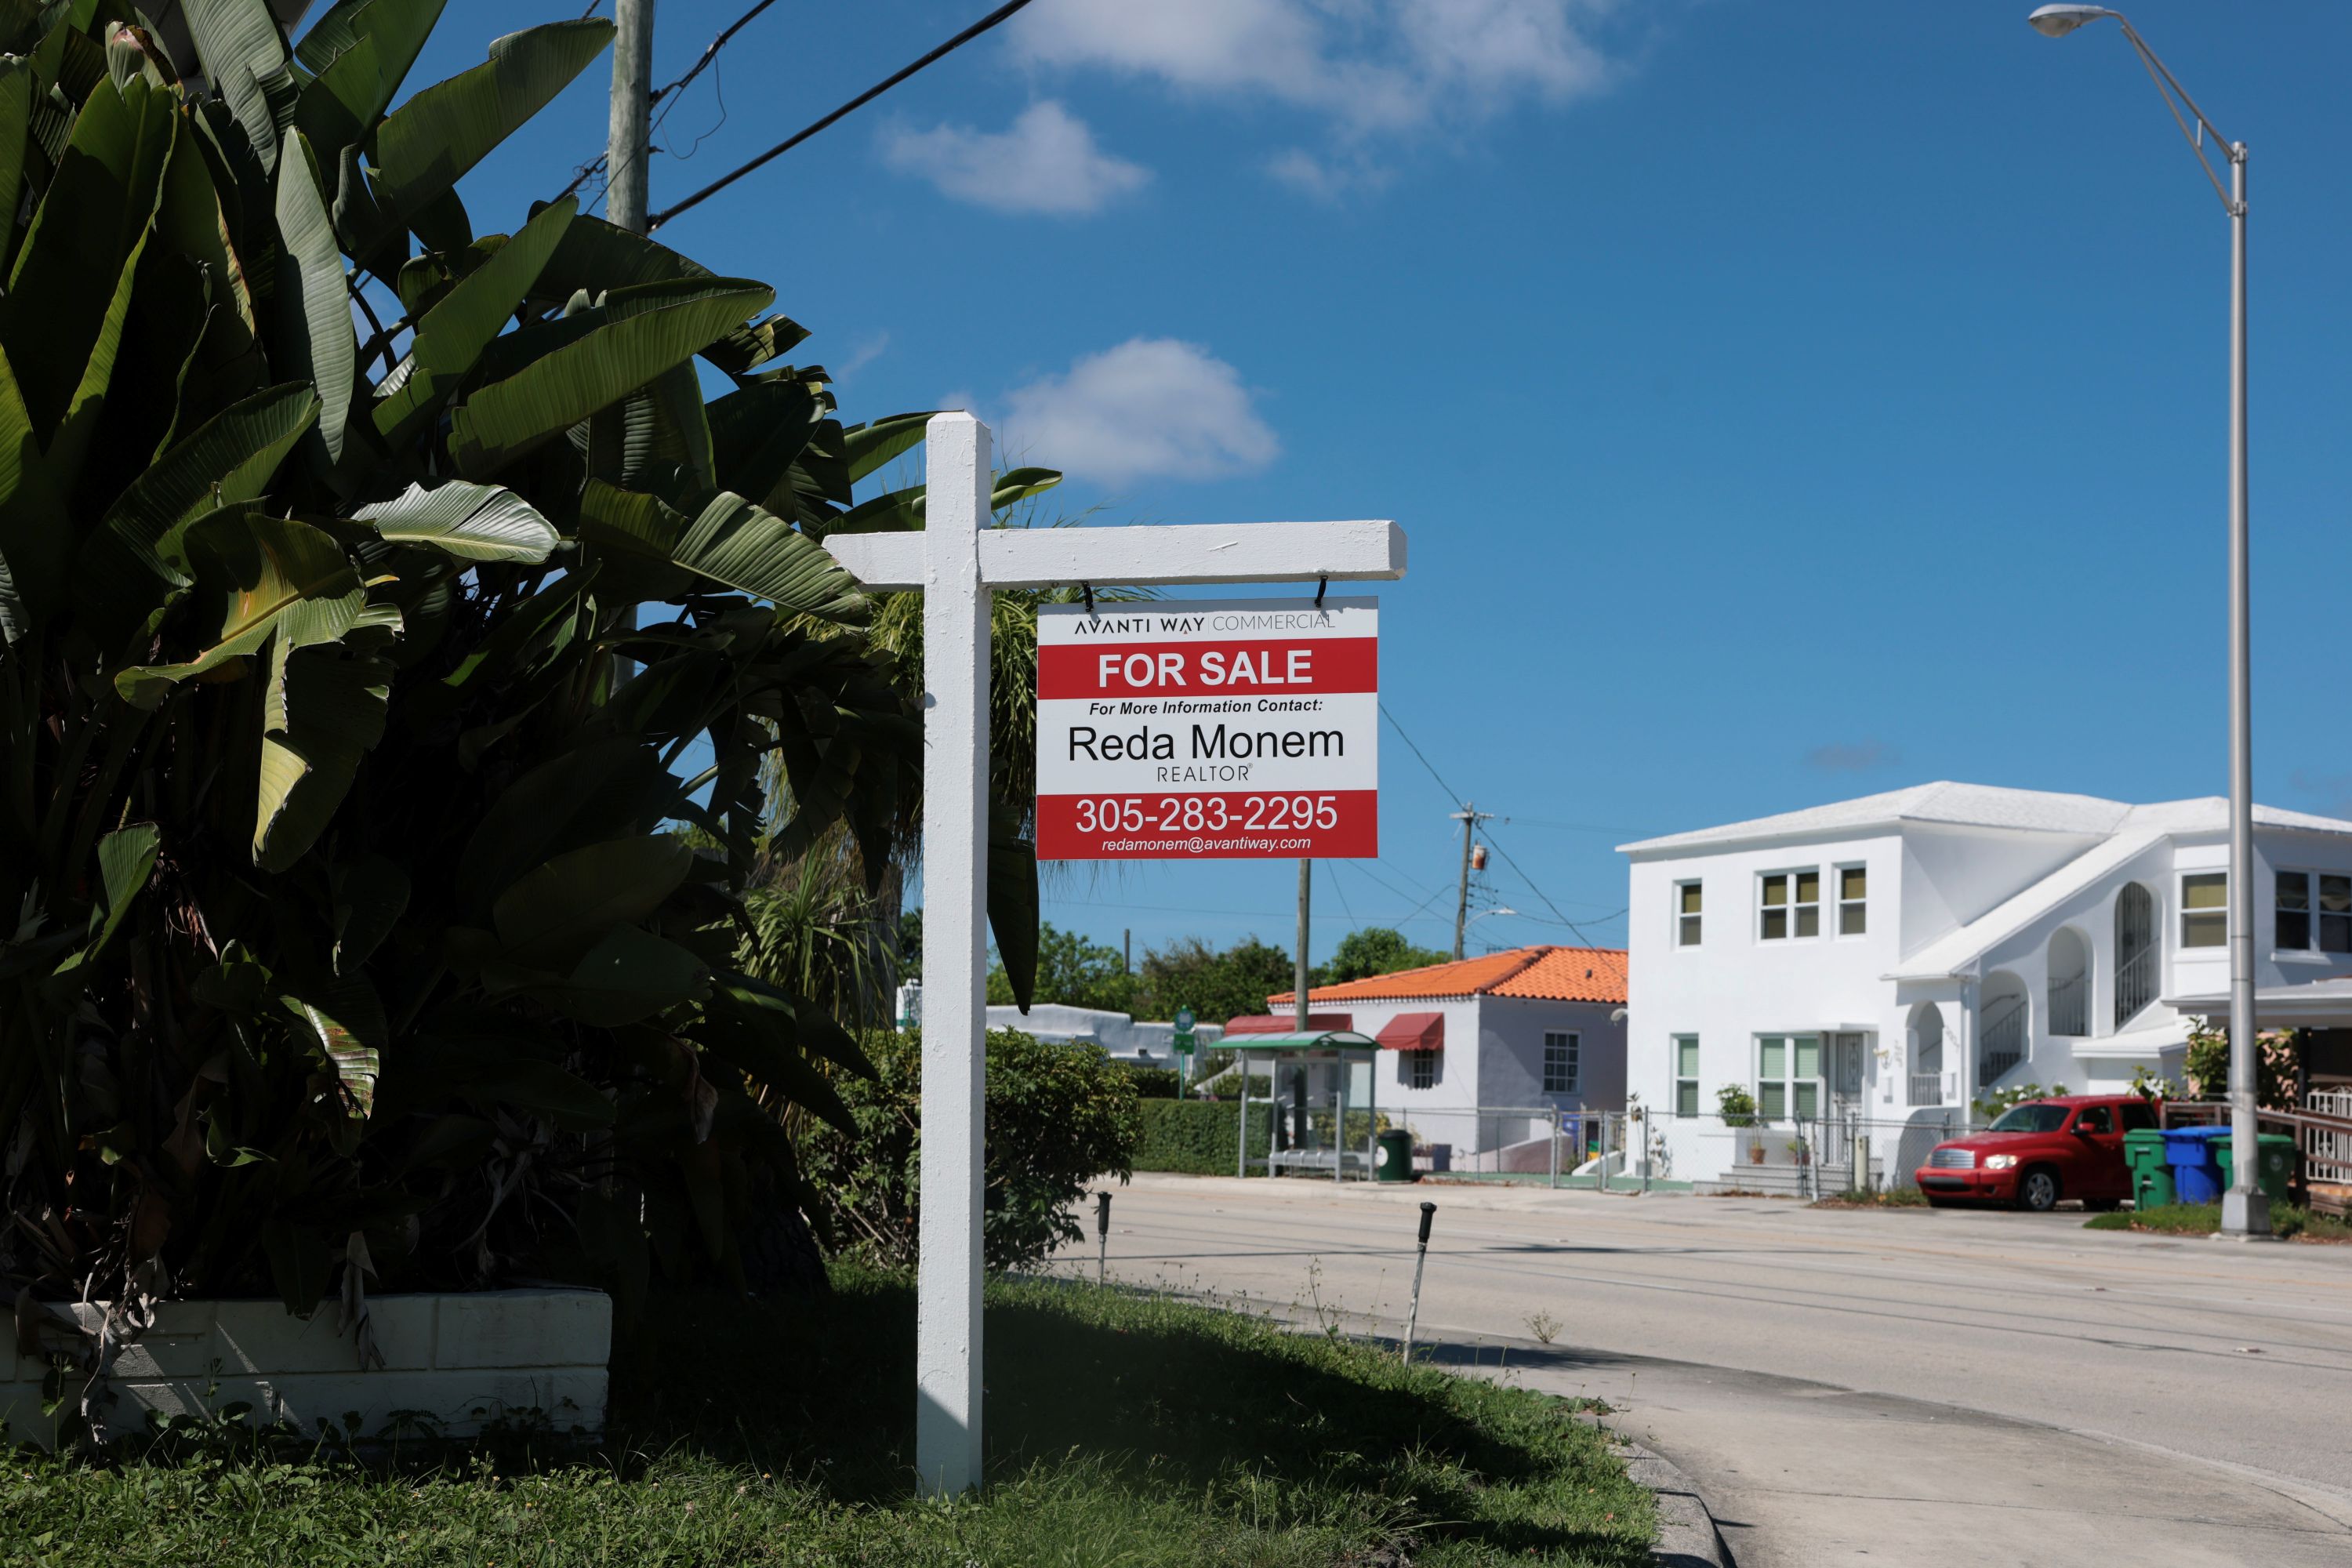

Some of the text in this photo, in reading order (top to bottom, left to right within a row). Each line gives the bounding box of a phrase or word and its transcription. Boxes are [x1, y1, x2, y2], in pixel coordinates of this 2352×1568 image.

[1075, 614, 1336, 634] AVANTI WAY COMMERCIAL
[1099, 650, 1312, 688] FOR SALE
[1089, 699, 1323, 716] For More Information Contact:
[1069, 724, 1344, 761] Reda Monem
[1076, 796, 1338, 833] 305-283-2295
[1102, 837, 1311, 852] redamonem@avantiway.com
